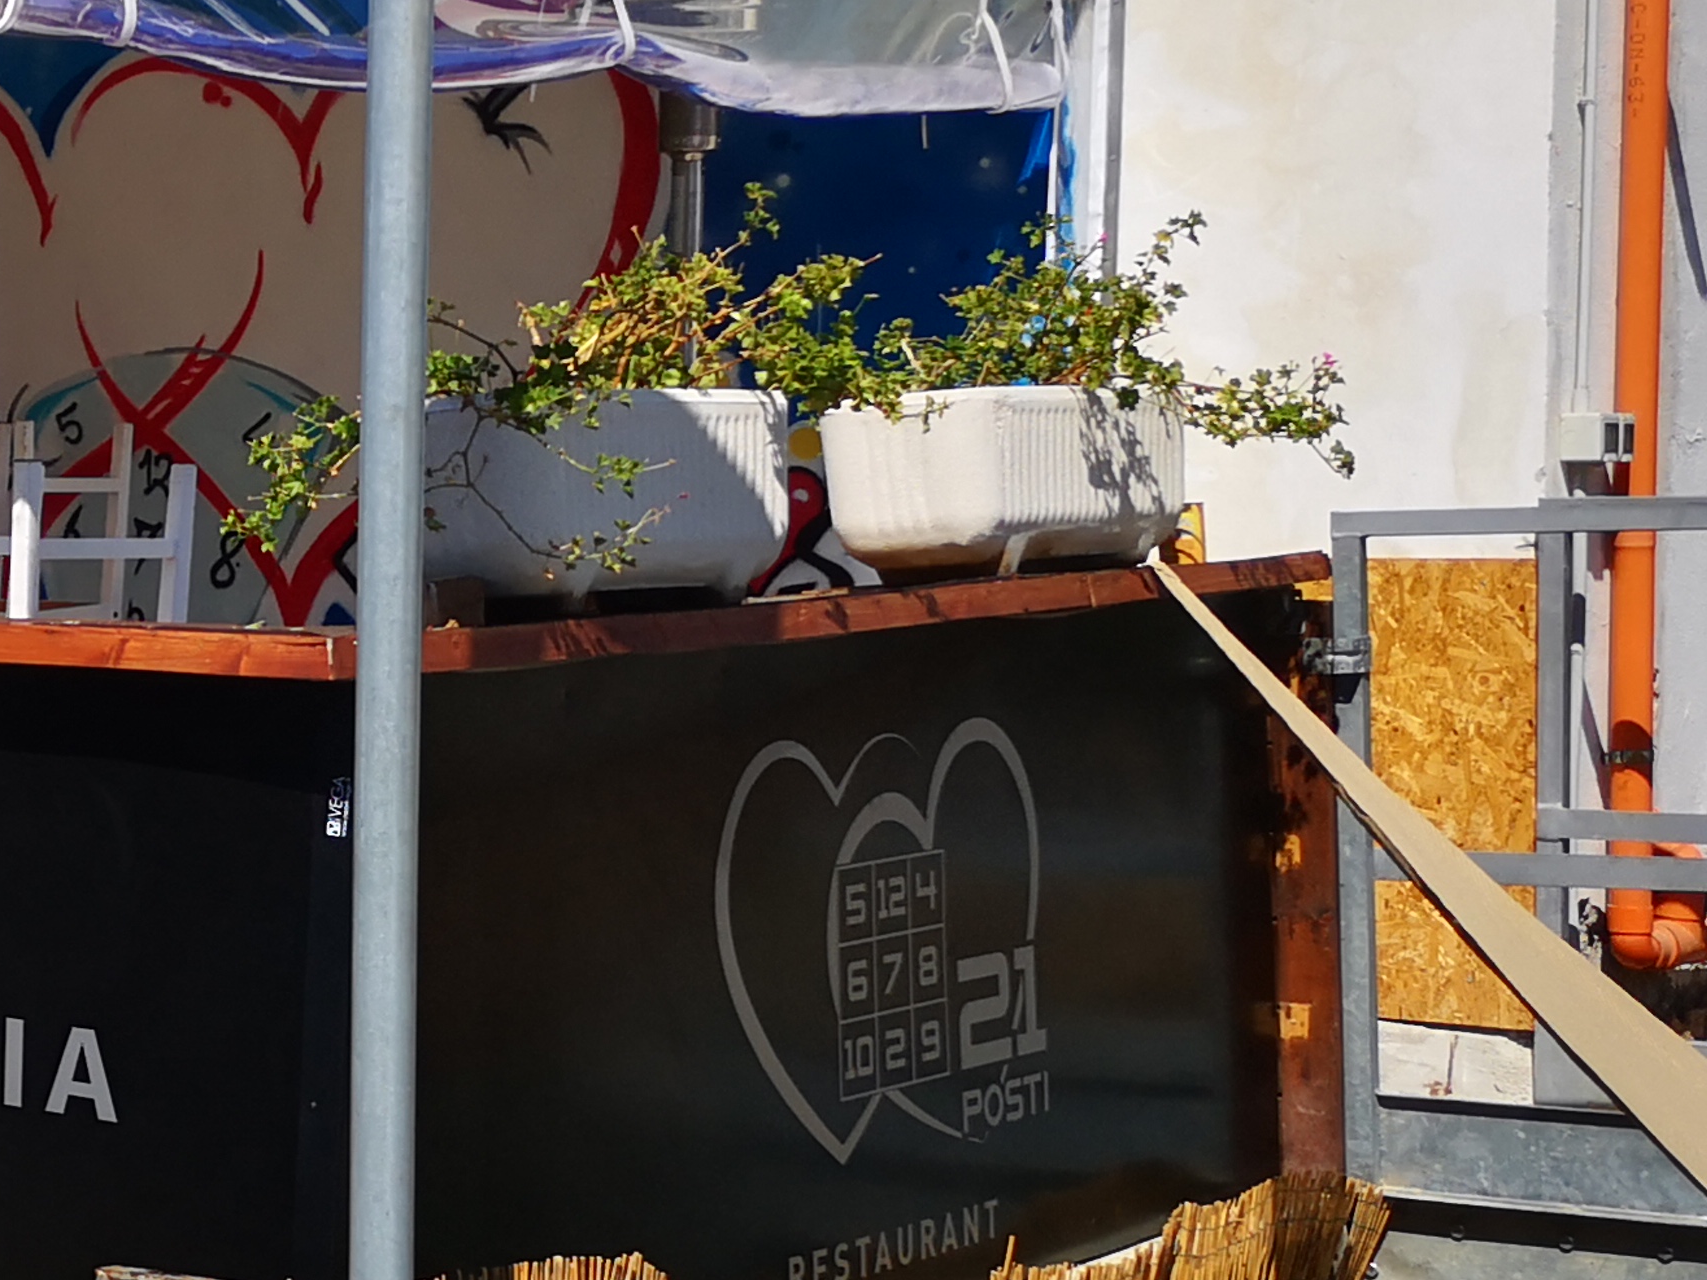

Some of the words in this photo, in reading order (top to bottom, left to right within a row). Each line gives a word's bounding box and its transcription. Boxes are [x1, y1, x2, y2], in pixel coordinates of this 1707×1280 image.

[54, 402, 85, 446] 5
[845, 882, 867, 926] 5
[876, 876, 906, 920] 12
[915, 870, 937, 910] 4
[846, 959, 867, 1002] 6
[883, 952, 904, 995] 7
[916, 945, 940, 987] 8
[957, 945, 1049, 1070] 21
[844, 1034, 875, 1079] 10
[884, 1028, 907, 1071] 2
[919, 1020, 941, 1063] 9
[962, 1071, 1051, 1135] POSTI
